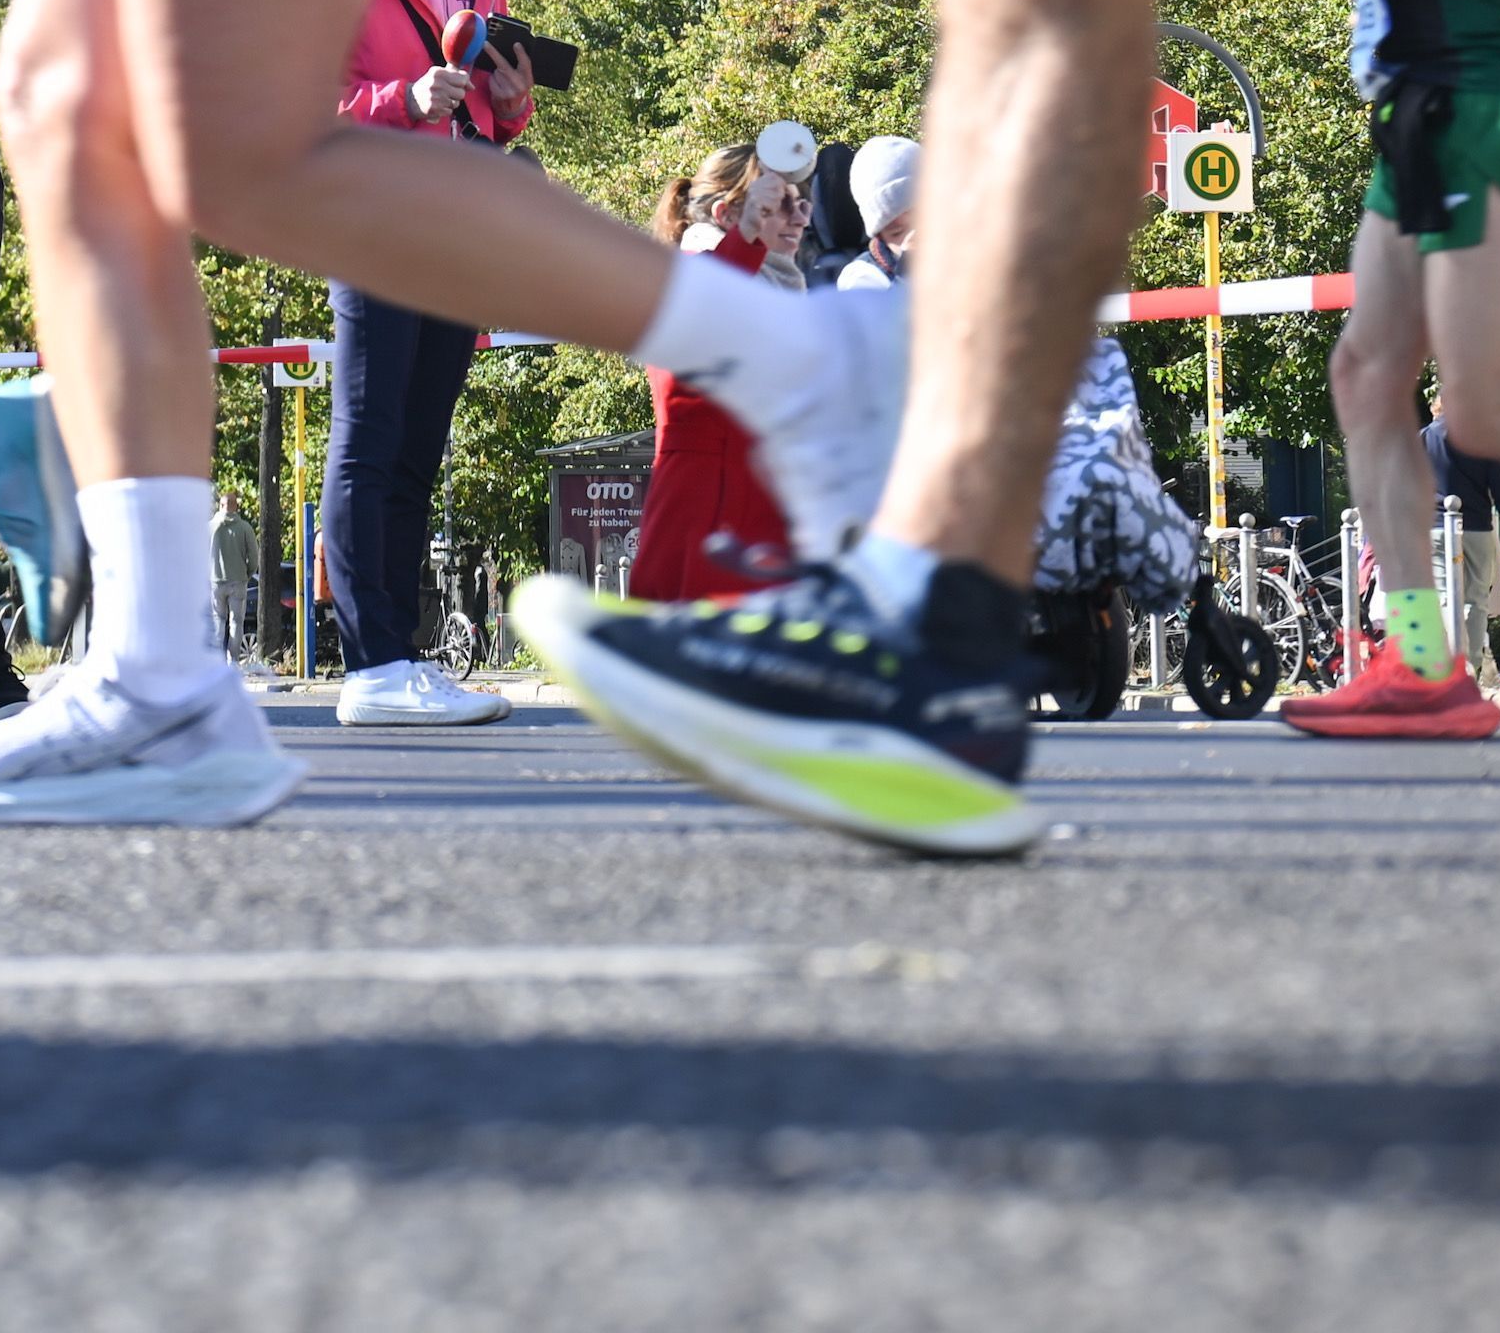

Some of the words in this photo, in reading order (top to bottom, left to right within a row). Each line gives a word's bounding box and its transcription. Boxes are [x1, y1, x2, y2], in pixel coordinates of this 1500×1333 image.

[1201, 156, 1227, 187] H
[586, 482, 634, 500] OTTO
[571, 507, 589, 517] Für
[589, 507, 616, 518] jeden
[588, 519, 600, 527] zu
[601, 518, 633, 527] haben.
